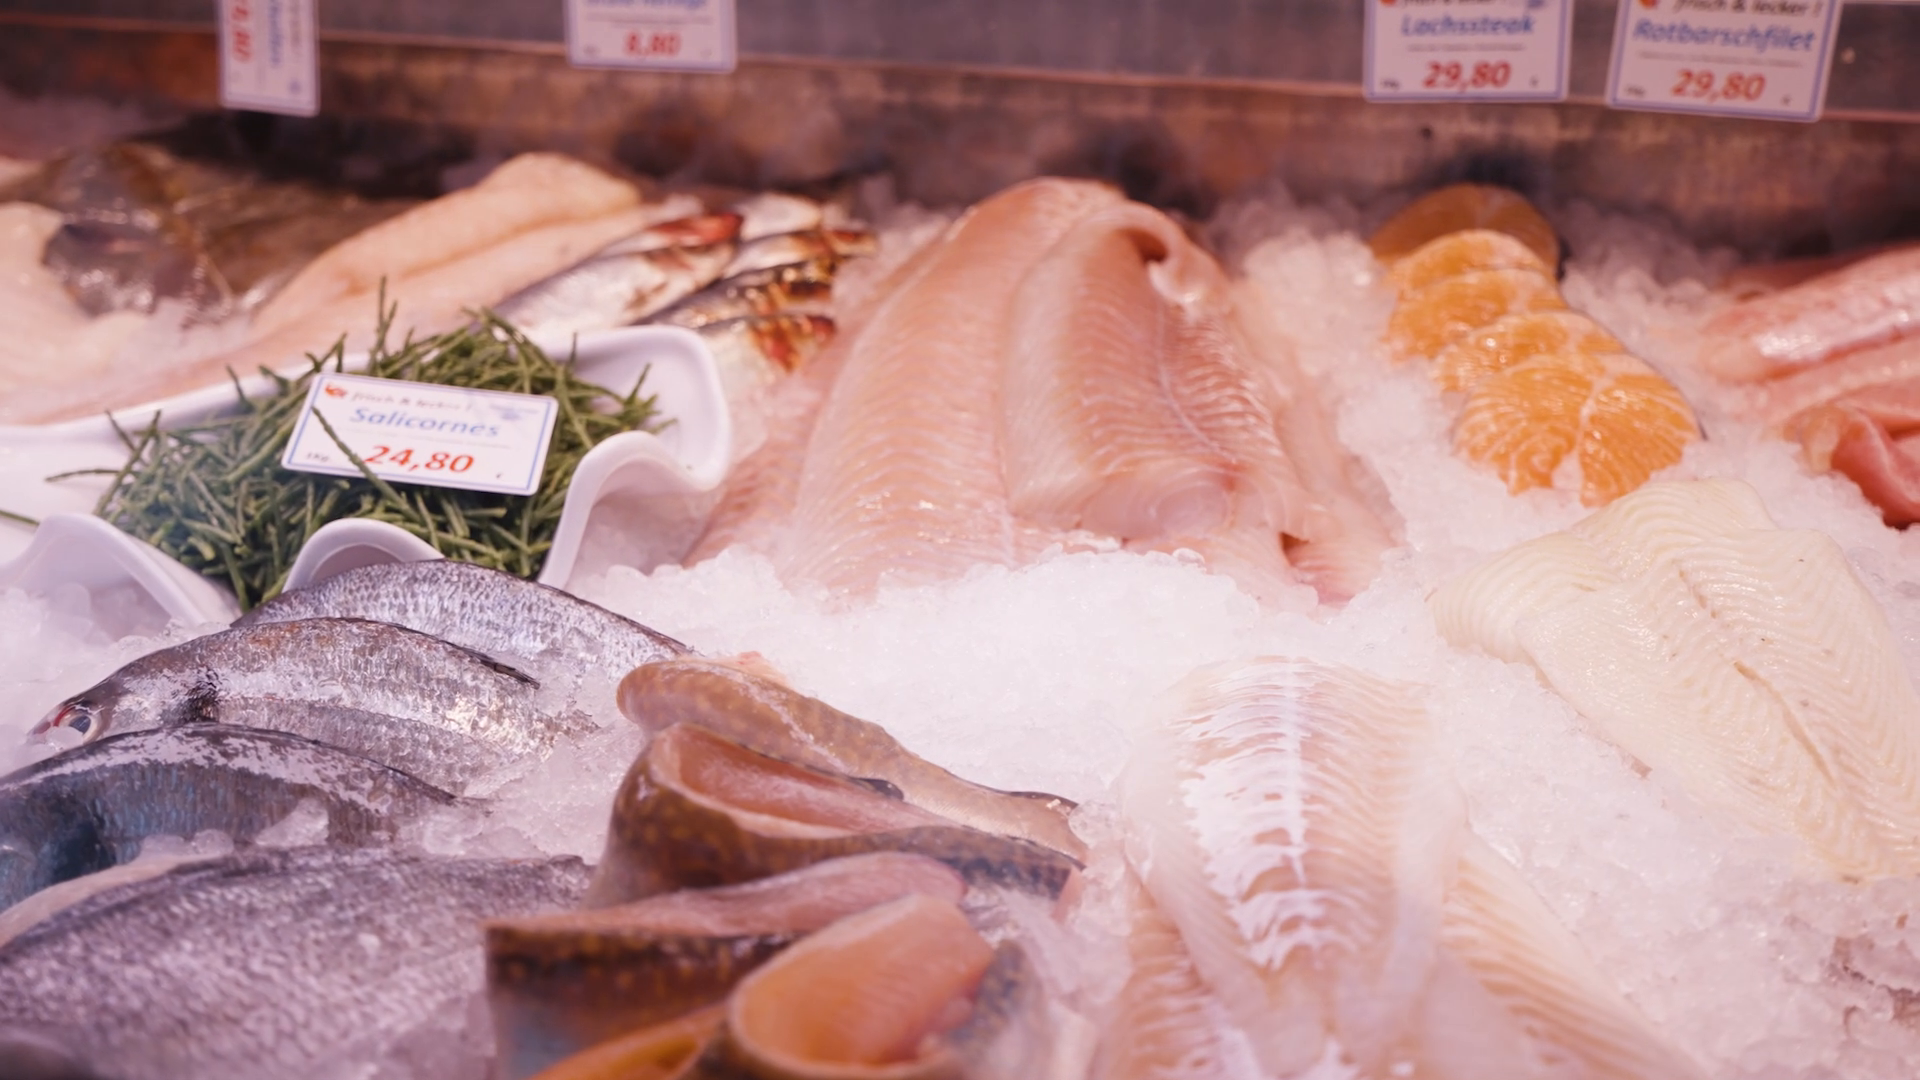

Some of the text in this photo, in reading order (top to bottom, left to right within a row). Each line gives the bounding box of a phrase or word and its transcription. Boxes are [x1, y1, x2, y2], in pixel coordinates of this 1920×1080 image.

[1633, 17, 1816, 53] Rotbarschfilet
[1422, 61, 1511, 93] 29,80
[1671, 69, 1766, 103] 29,80
[350, 406, 500, 438] Salicornes
[363, 445, 475, 473] 24,80
